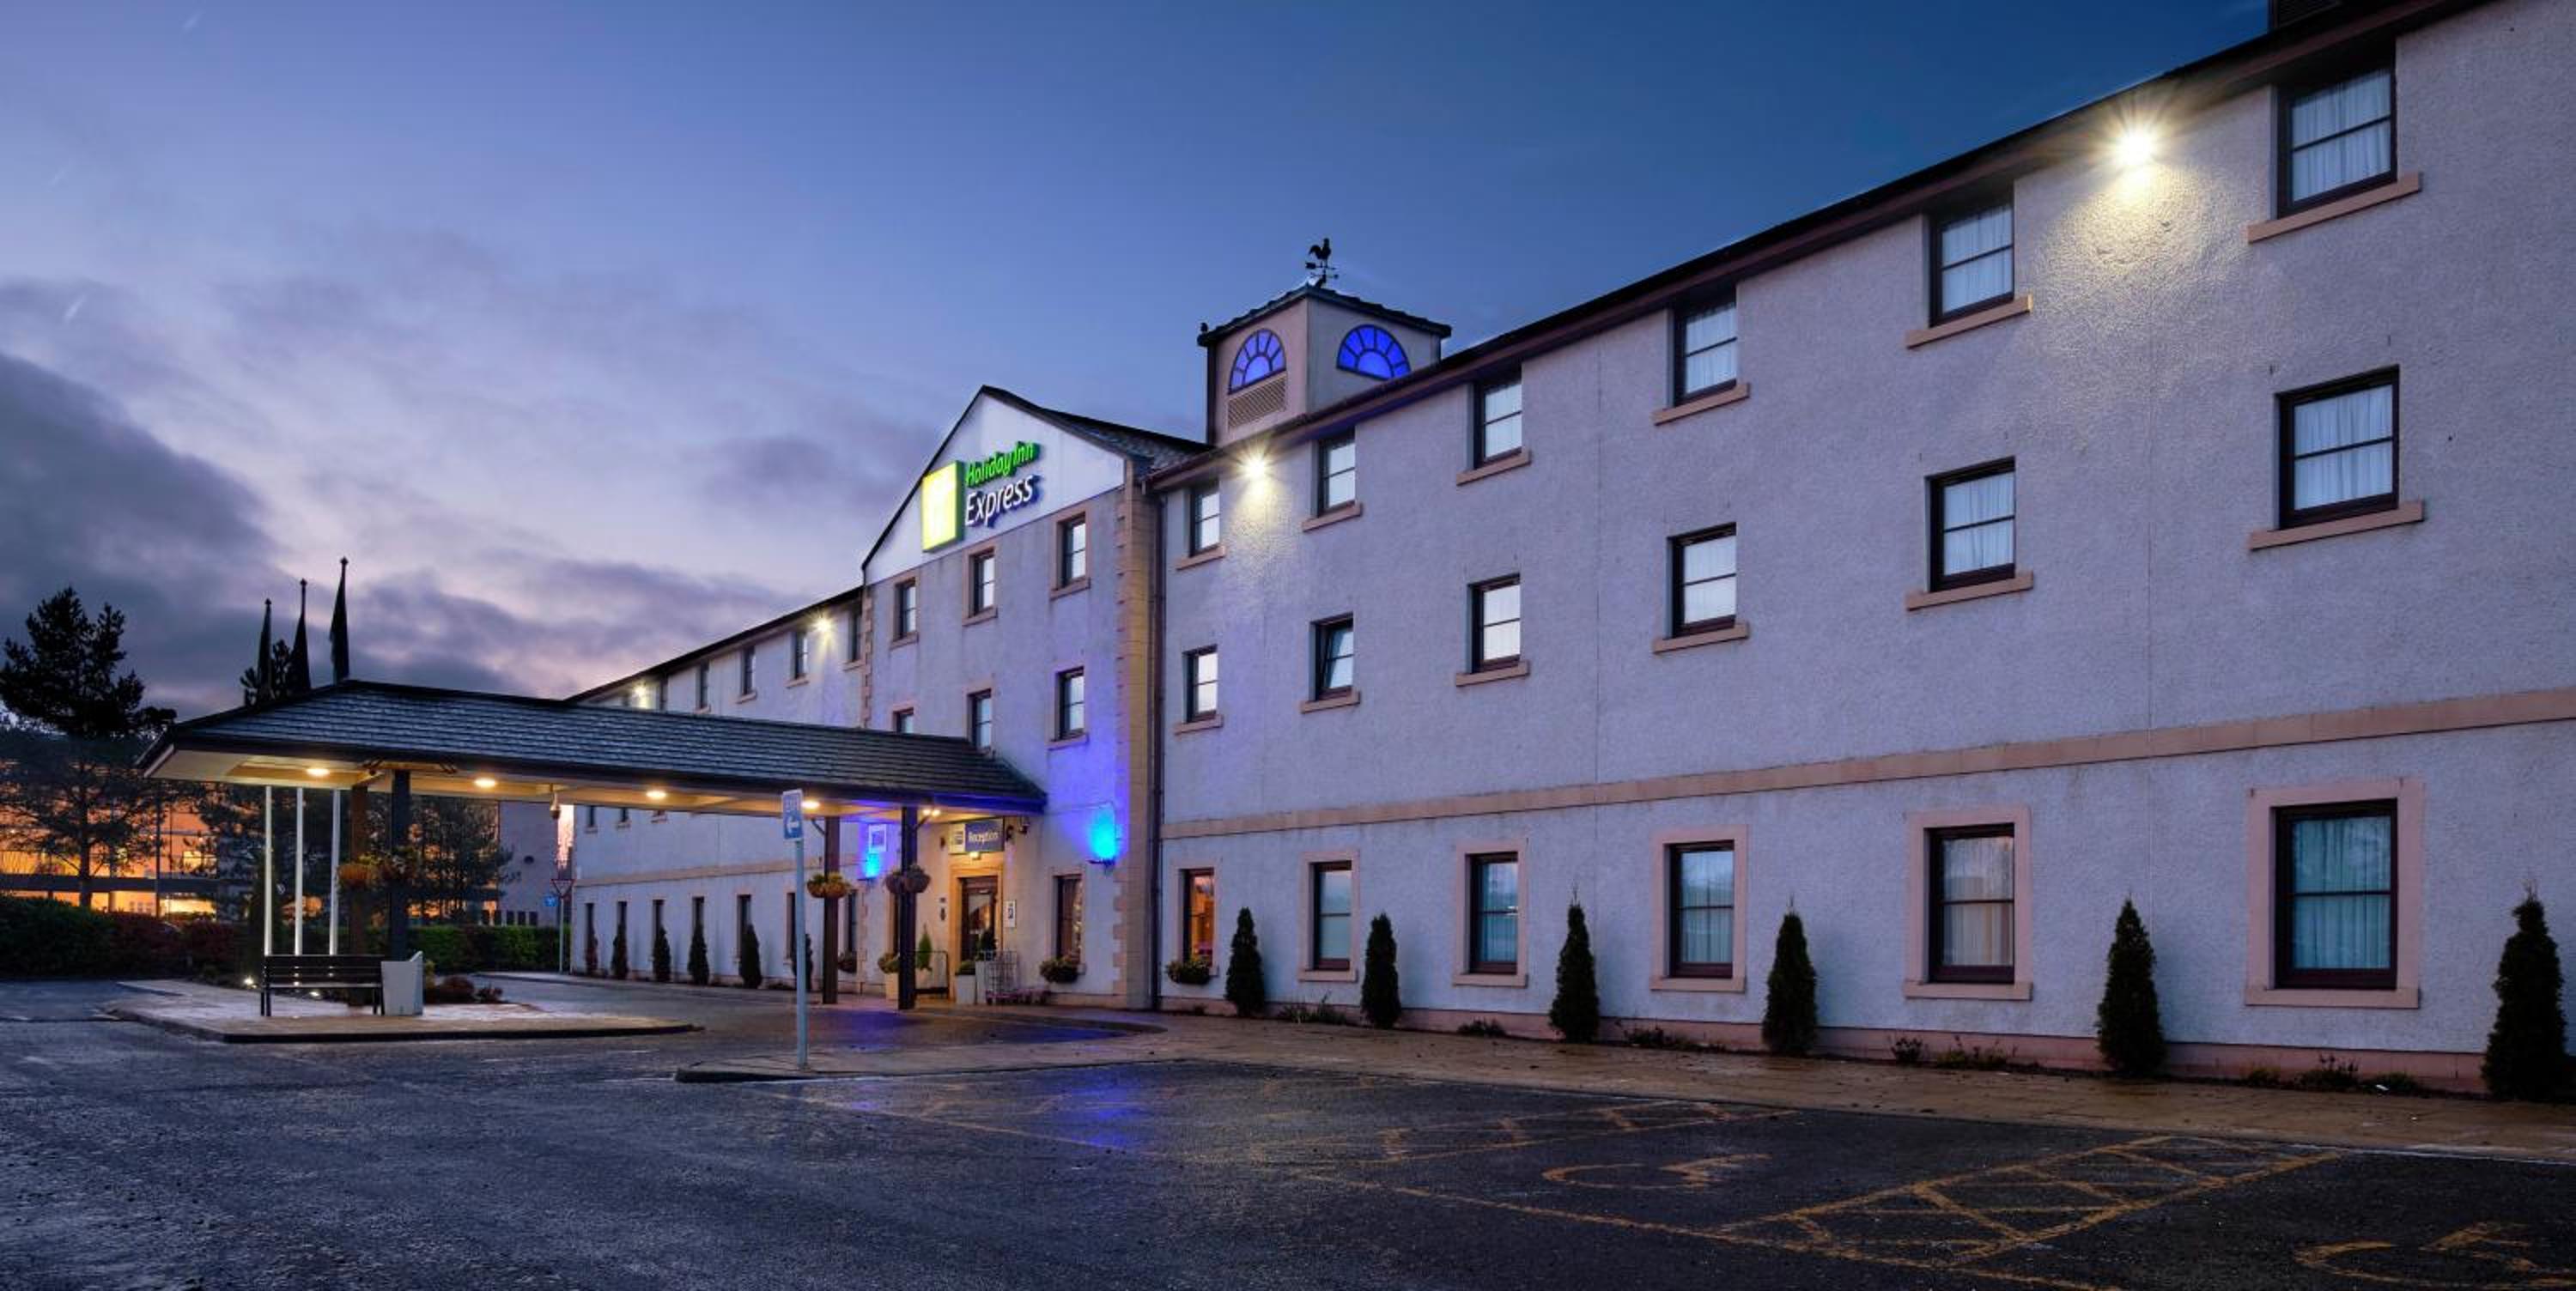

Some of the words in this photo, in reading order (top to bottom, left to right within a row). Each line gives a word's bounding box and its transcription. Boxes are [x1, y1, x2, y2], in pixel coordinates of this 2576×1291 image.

[966, 452, 1013, 487] Holiday
[1012, 441, 1036, 465] Inn
[965, 475, 1035, 527] Express
[968, 831, 999, 846] Reception
